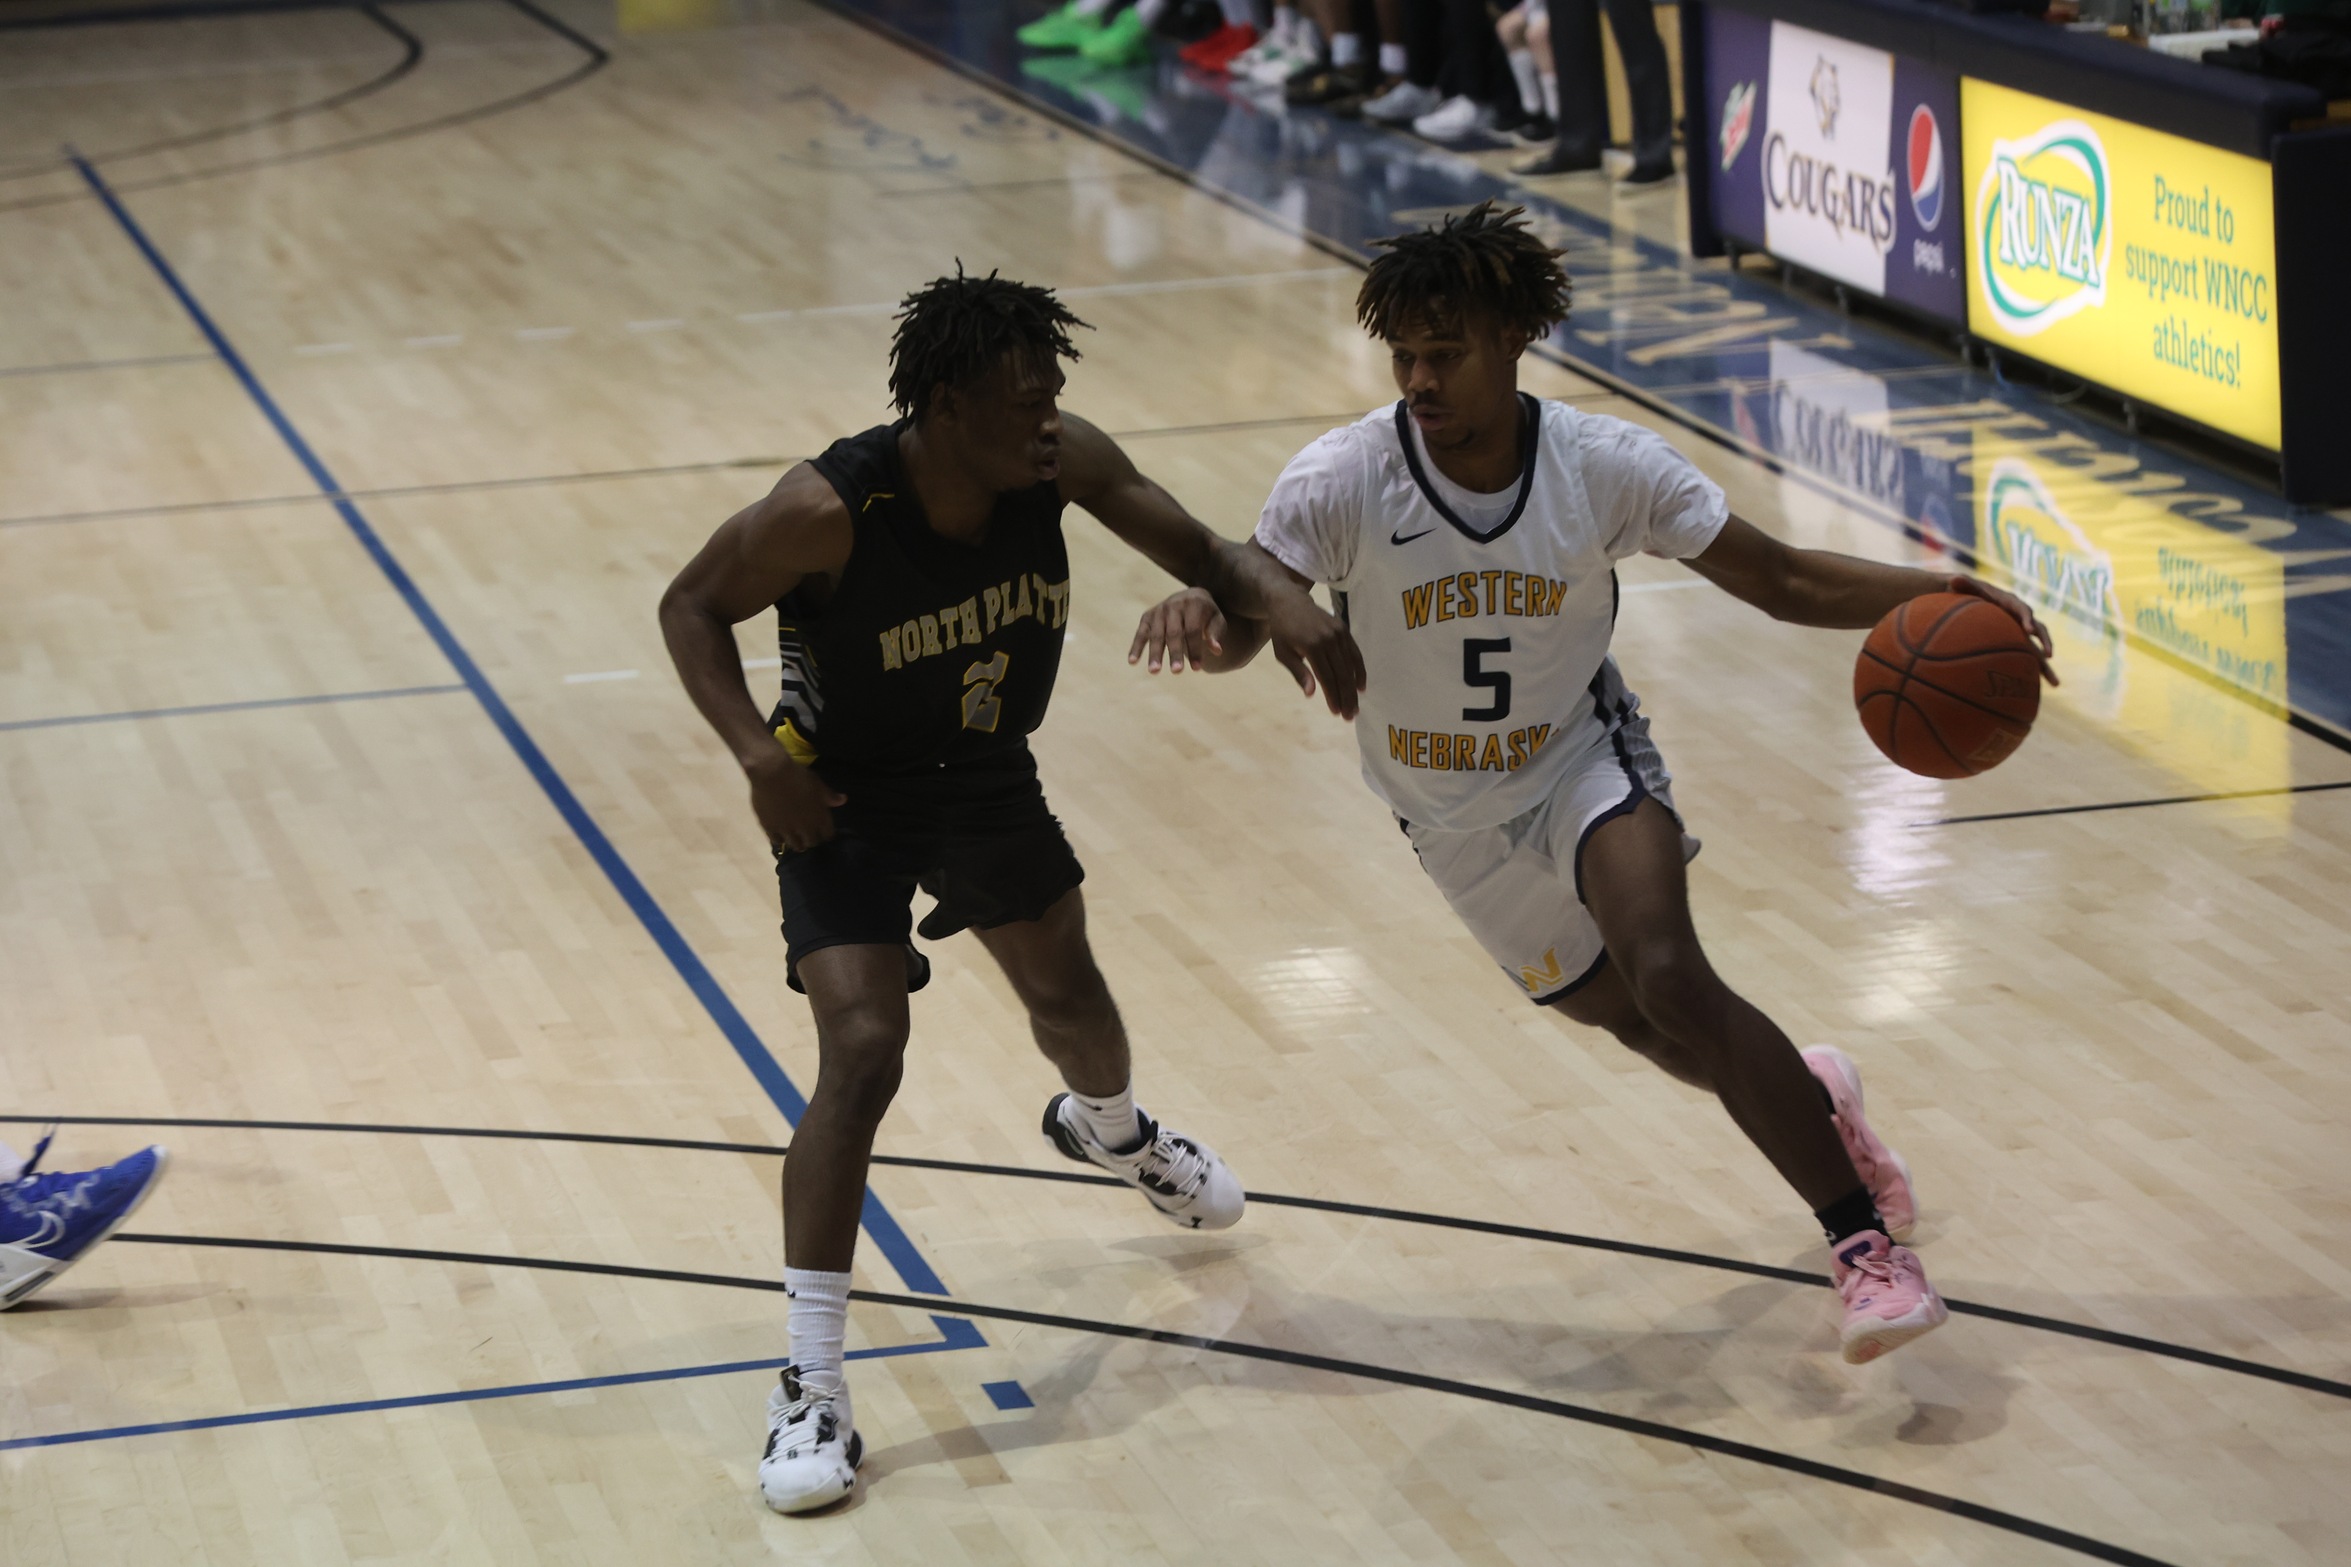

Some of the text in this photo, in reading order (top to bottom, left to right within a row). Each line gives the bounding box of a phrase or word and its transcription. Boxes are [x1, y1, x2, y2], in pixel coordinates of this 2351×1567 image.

[1766, 131, 1893, 254] COUGARS
[1998, 155, 2100, 288] RUNZA
[2154, 175, 2234, 243] Proud to
[2126, 243, 2267, 322] support WNCC
[2154, 314, 2240, 388] athletics!
[879, 595, 982, 672] NORTH
[1402, 570, 1567, 630] WESTERN
[961, 650, 1010, 734] 2
[1462, 637, 1511, 722] 5
[1388, 723, 1560, 772] NEBRASK
